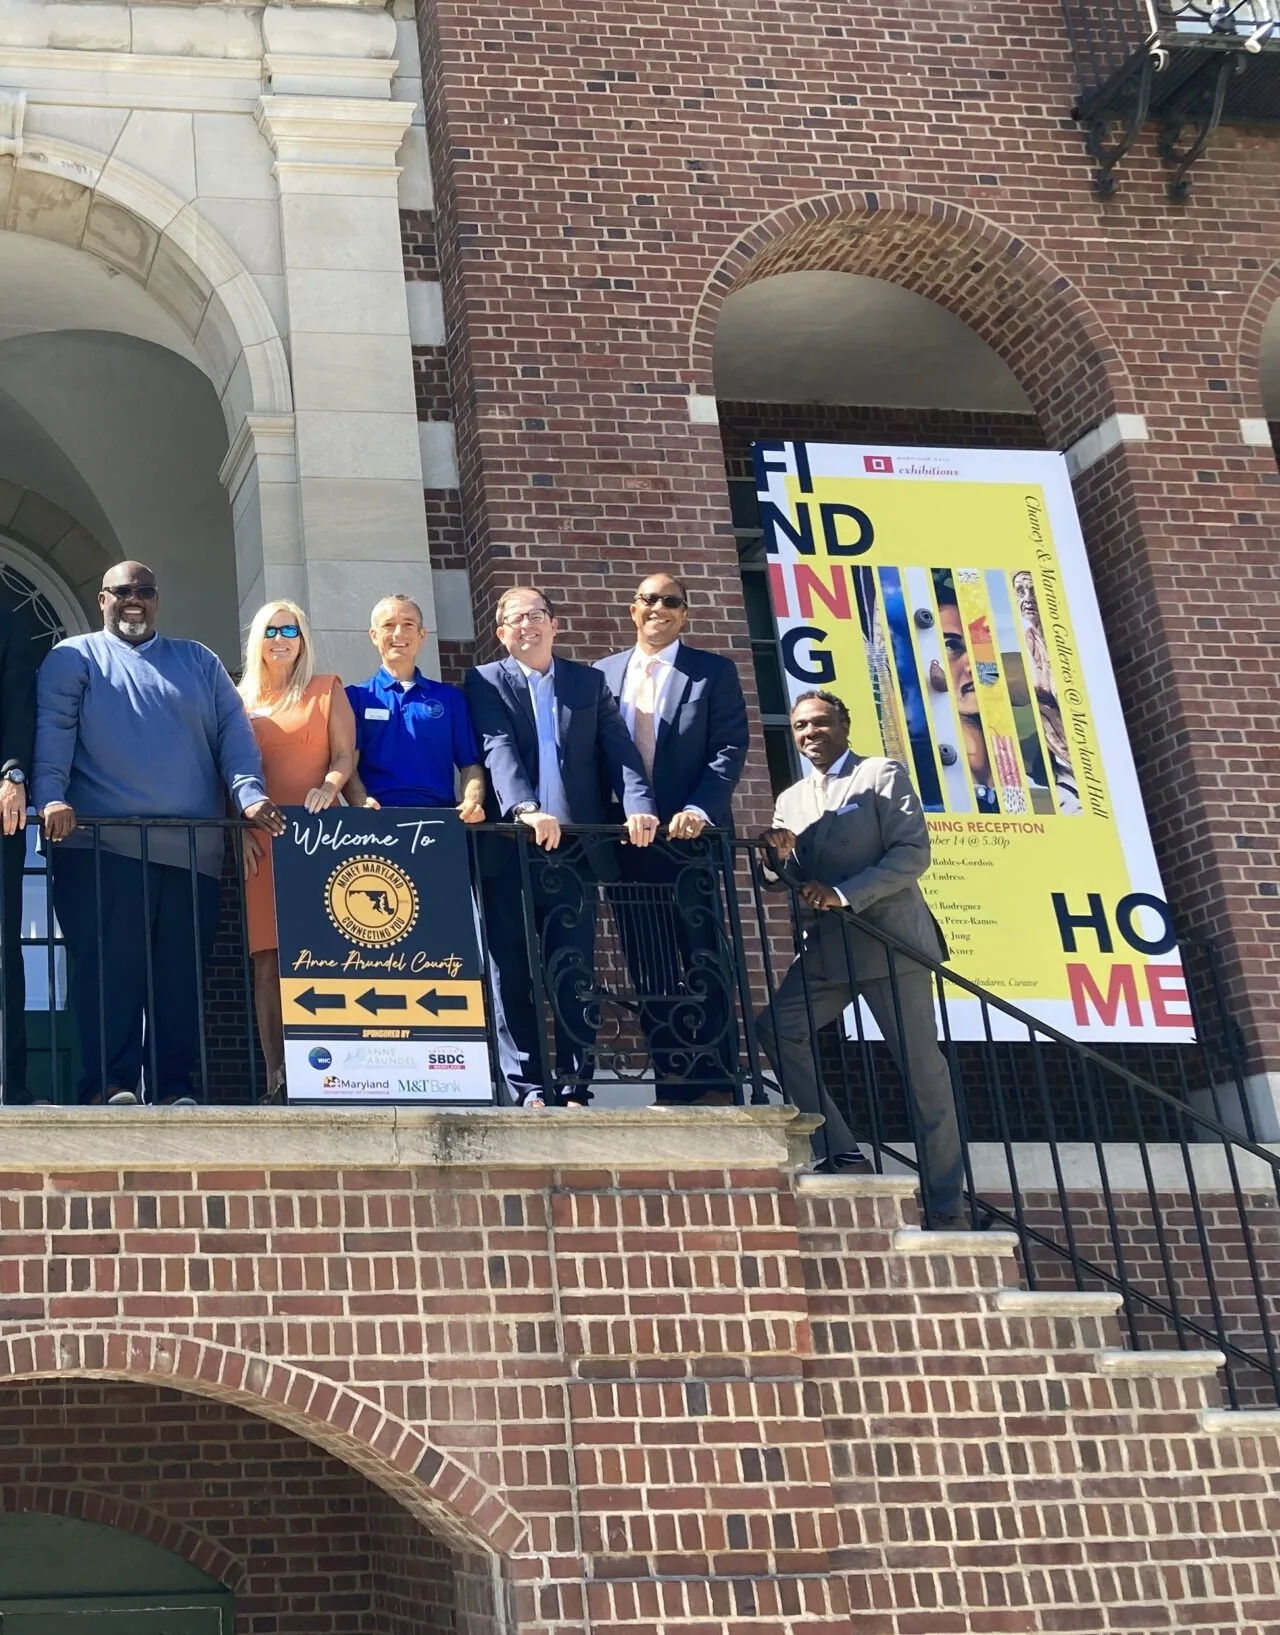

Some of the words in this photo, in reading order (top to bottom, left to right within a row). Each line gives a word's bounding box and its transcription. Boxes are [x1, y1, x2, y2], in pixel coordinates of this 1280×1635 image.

[754, 441, 814, 493] FI
[899, 464, 959, 476] exhibitions
[758, 501, 875, 556] ND
[1025, 495, 1043, 543] Chaney
[1036, 549, 1051, 562] &
[768, 563, 852, 620] IN
[1039, 565, 1060, 620] Marino
[780, 625, 837, 685] G
[1053, 623, 1076, 686] Galleries
[1064, 688, 1082, 705] @
[1070, 709, 1101, 783] Maryland
[1088, 783, 1109, 819] Hall
[293, 819, 398, 855] Welcome
[397, 820, 445, 854] To
[927, 821, 963, 832] NING
[968, 822, 1045, 834] RECEPTION
[953, 835, 965, 845] 14
[968, 837, 980, 847] @
[982, 836, 1010, 848] 5.30p
[336, 864, 361, 889] MONEY
[362, 863, 404, 890] MARYLAND
[341, 916, 391, 940] CONNECTING
[391, 916, 406, 933] YOU
[1051, 892, 1178, 956] HO
[292, 948, 338, 971] Anne
[341, 949, 406, 972] Arundel
[410, 950, 463, 978] County
[1066, 963, 1195, 1028] ME
[362, 1029, 400, 1038] SPONSORED
[401, 1030, 410, 1038] BY
[428, 1053, 465, 1064] SBDC
[341, 1080, 389, 1090] Maryland
[398, 1079, 430, 1093] M&T
[431, 1079, 462, 1093] Bank
